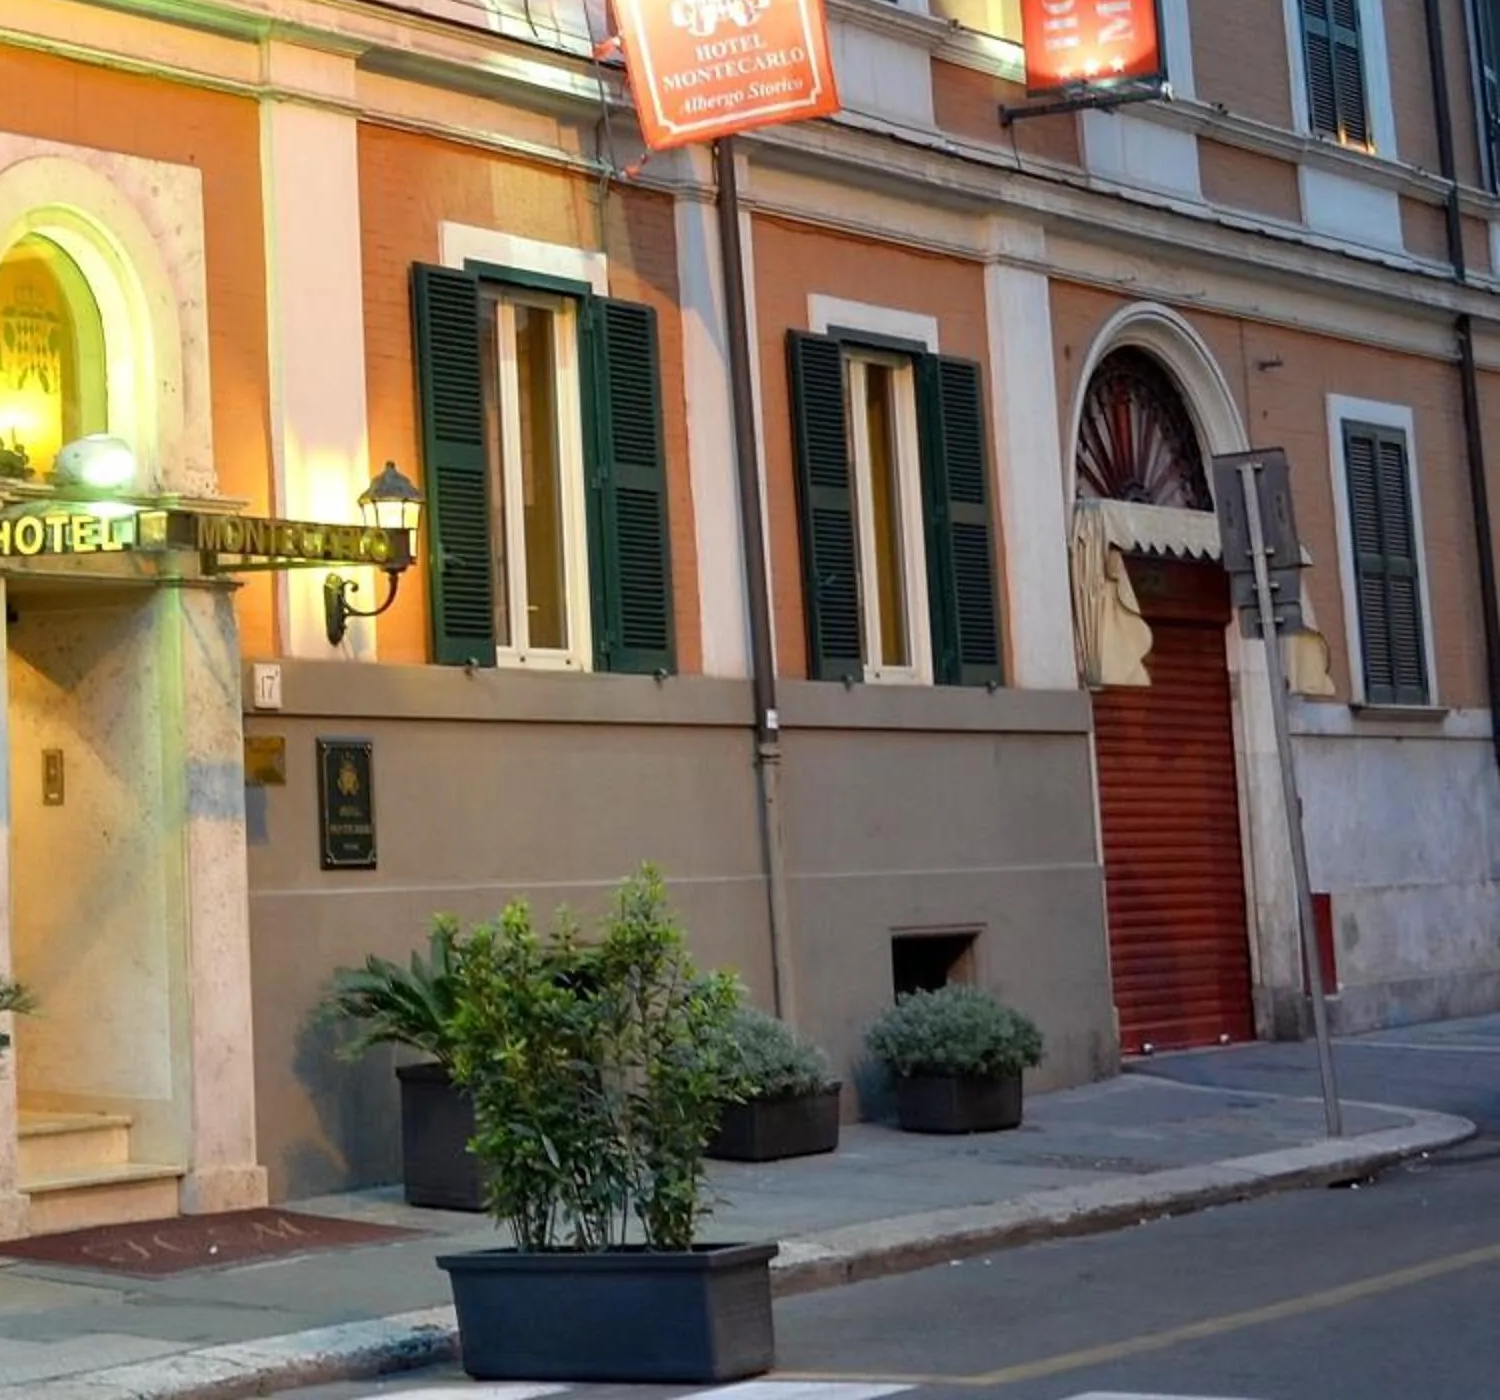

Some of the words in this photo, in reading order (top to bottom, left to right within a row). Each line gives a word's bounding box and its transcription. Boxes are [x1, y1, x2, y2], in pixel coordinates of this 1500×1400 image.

[694, 33, 766, 62] HOTEL
[661, 46, 806, 91] MONTECARLO
[679, 89, 745, 115] Albergo
[198, 515, 390, 562] MONTECARLO
